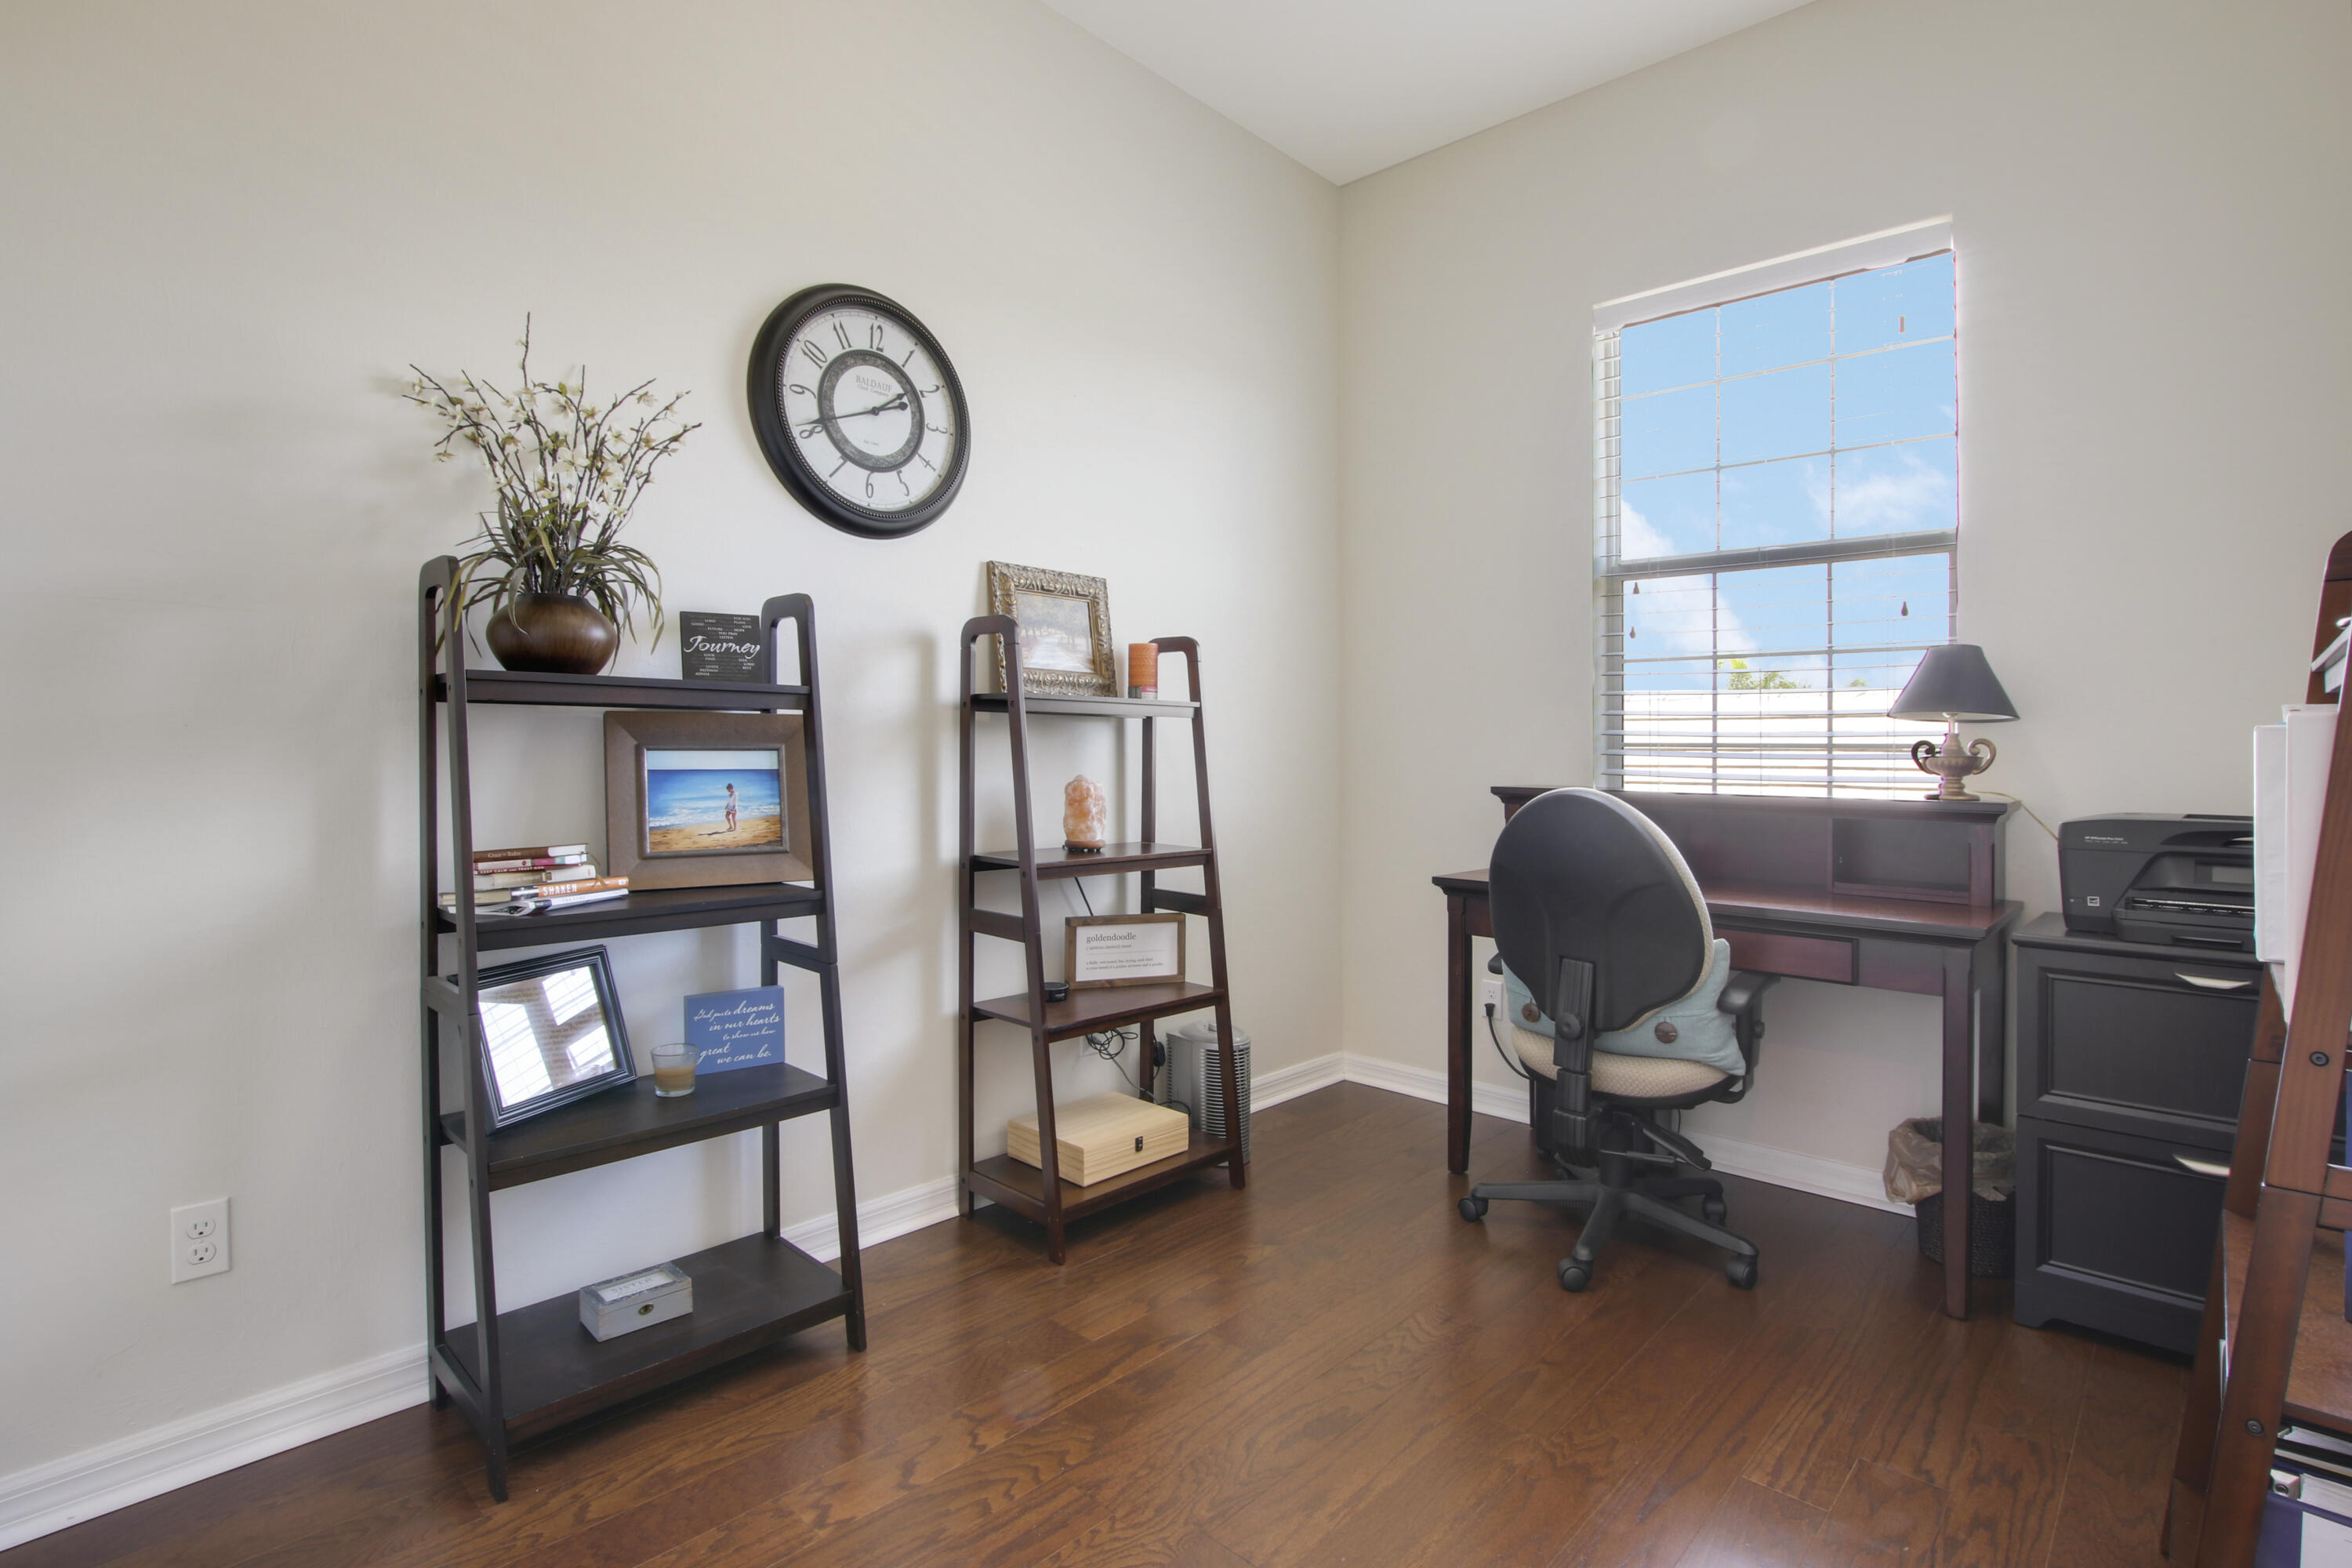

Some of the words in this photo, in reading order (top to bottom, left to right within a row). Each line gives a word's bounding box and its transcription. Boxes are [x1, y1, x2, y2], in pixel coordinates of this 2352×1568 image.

[833, 320, 852, 350] 11
[869, 322, 884, 352] 12
[800, 339, 828, 370] 10
[901, 349, 916, 368] 1
[789, 383, 816, 399] 9
[919, 384, 941, 398] 2
[799, 425, 824, 439] 8
[926, 423, 948, 434] 3
[916, 452, 936, 472] 4
[866, 470, 874, 499] 6
[896, 470, 909, 496] 5
[683, 635, 760, 659] Journey
[543, 883, 578, 896] SHAKEN
[1087, 932, 1136, 944] goldendoodle
[733, 1000, 775, 1015] dreams
[709, 1022, 723, 1031] in
[724, 1021, 745, 1029] our
[746, 1013, 781, 1026] hearts
[731, 1029, 751, 1040] show
[760, 1026, 776, 1035] how
[695, 1042, 731, 1065] great
[717, 1055, 733, 1064] we
[733, 1053, 756, 1062] can
